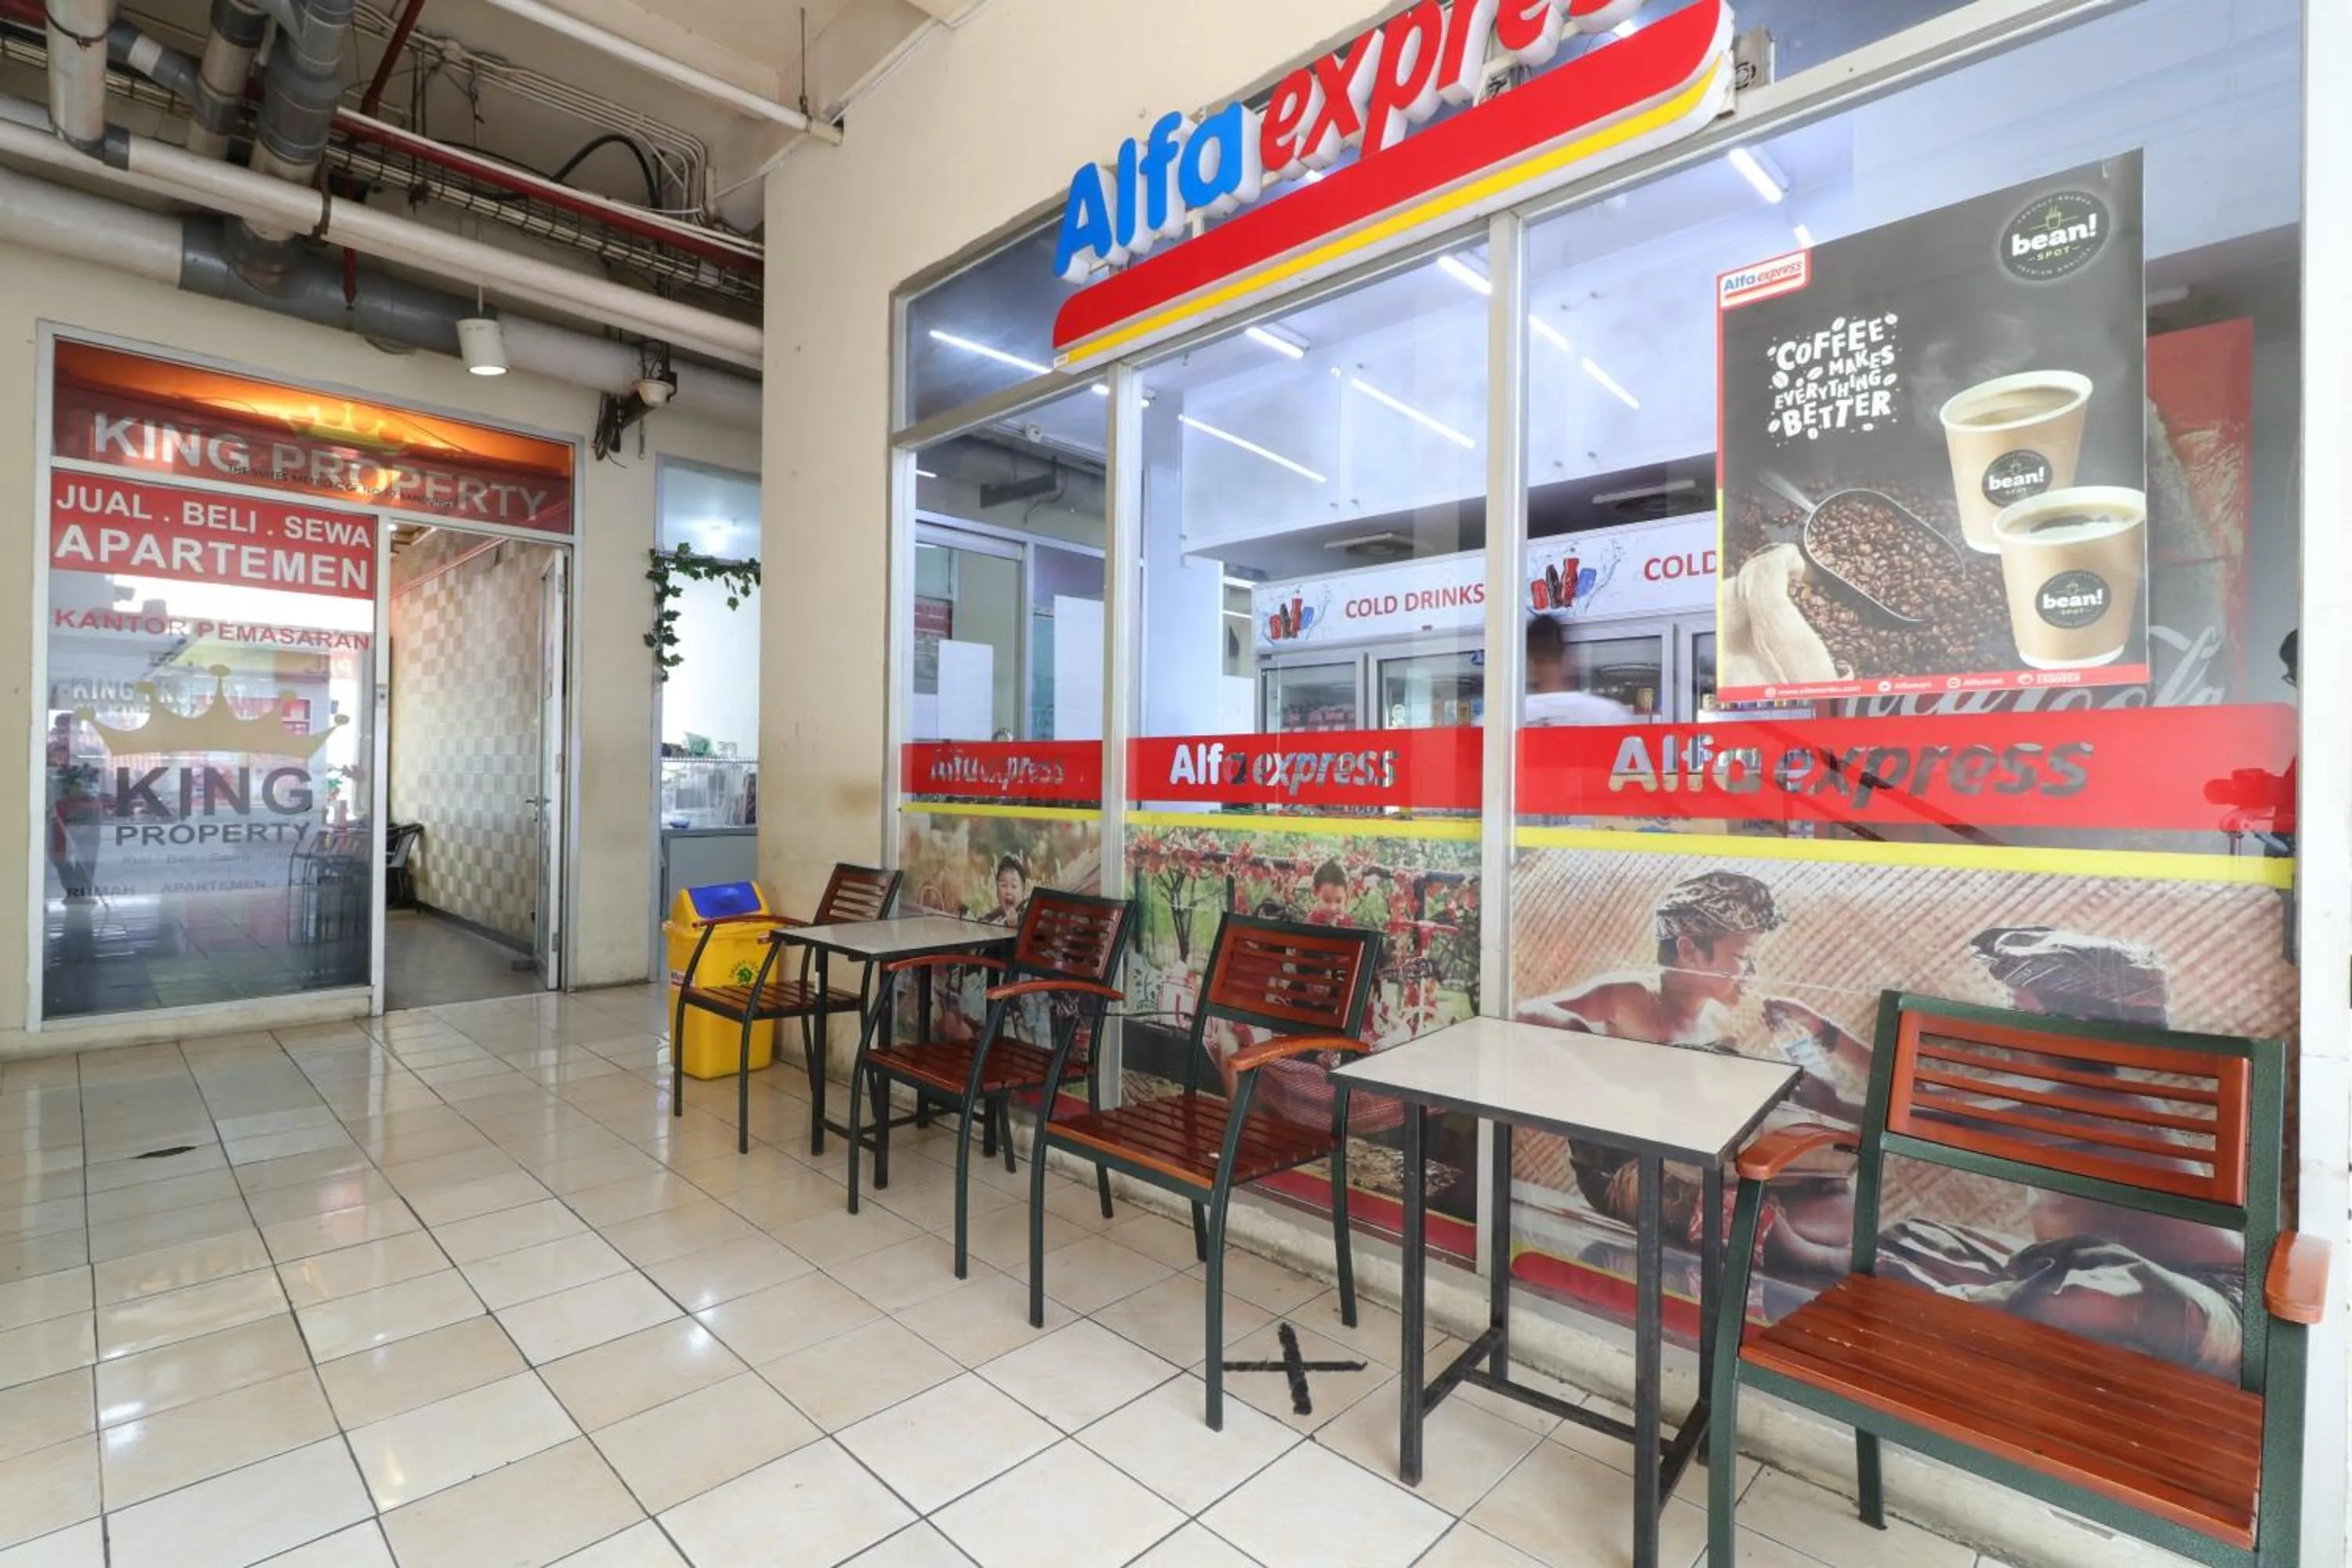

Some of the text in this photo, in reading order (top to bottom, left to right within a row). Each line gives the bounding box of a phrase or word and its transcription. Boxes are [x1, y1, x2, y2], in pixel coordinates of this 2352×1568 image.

[1053, 0, 1626, 281] Alfa expr
[2011, 212, 2097, 256] bean!
[2037, 245, 2071, 261] SPOT
[1723, 260, 1802, 292] Alfa express
[1776, 318, 1885, 371] COFFEE
[1828, 345, 1895, 376] MAKES
[1774, 368, 1882, 410] EVERYTHING
[1781, 390, 1891, 437] BETTER
[93, 412, 249, 470] KING
[271, 441, 549, 521] PROPERTY
[1988, 466, 2045, 491] bean!
[56, 484, 372, 548] JUAL BELI SEWA
[54, 523, 368, 591] APARTEMEN
[1345, 582, 1486, 619] COLD DRINKS
[2042, 588, 2104, 610] bean!
[53, 608, 370, 652] KANTOR PEMASARAN
[1169, 742, 1399, 796] Alfa express
[1608, 734, 2094, 809] Alfa express
[115, 765, 314, 818] KING
[115, 821, 310, 848] PROPERTY
